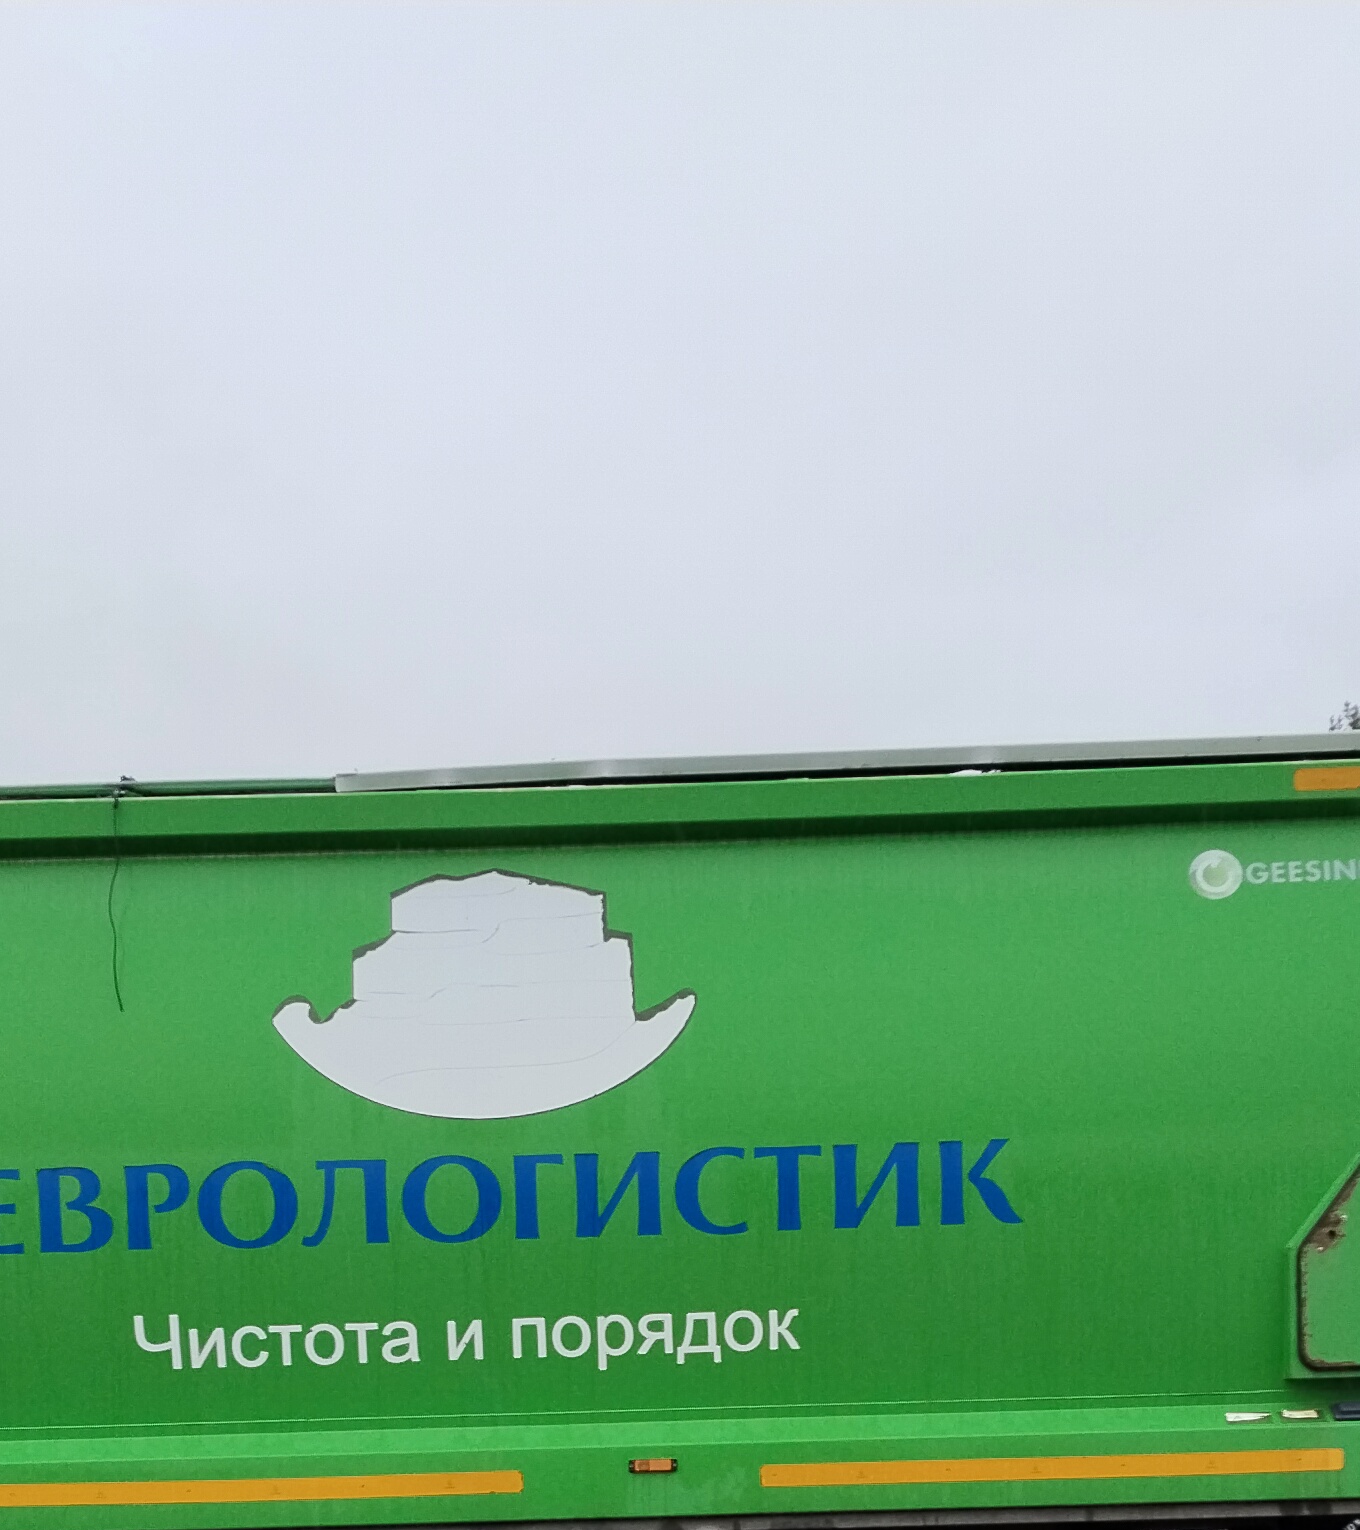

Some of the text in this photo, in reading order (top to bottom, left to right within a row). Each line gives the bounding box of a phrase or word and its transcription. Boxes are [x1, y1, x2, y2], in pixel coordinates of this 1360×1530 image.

[133, 1309, 801, 1370] Чистота и порядок
